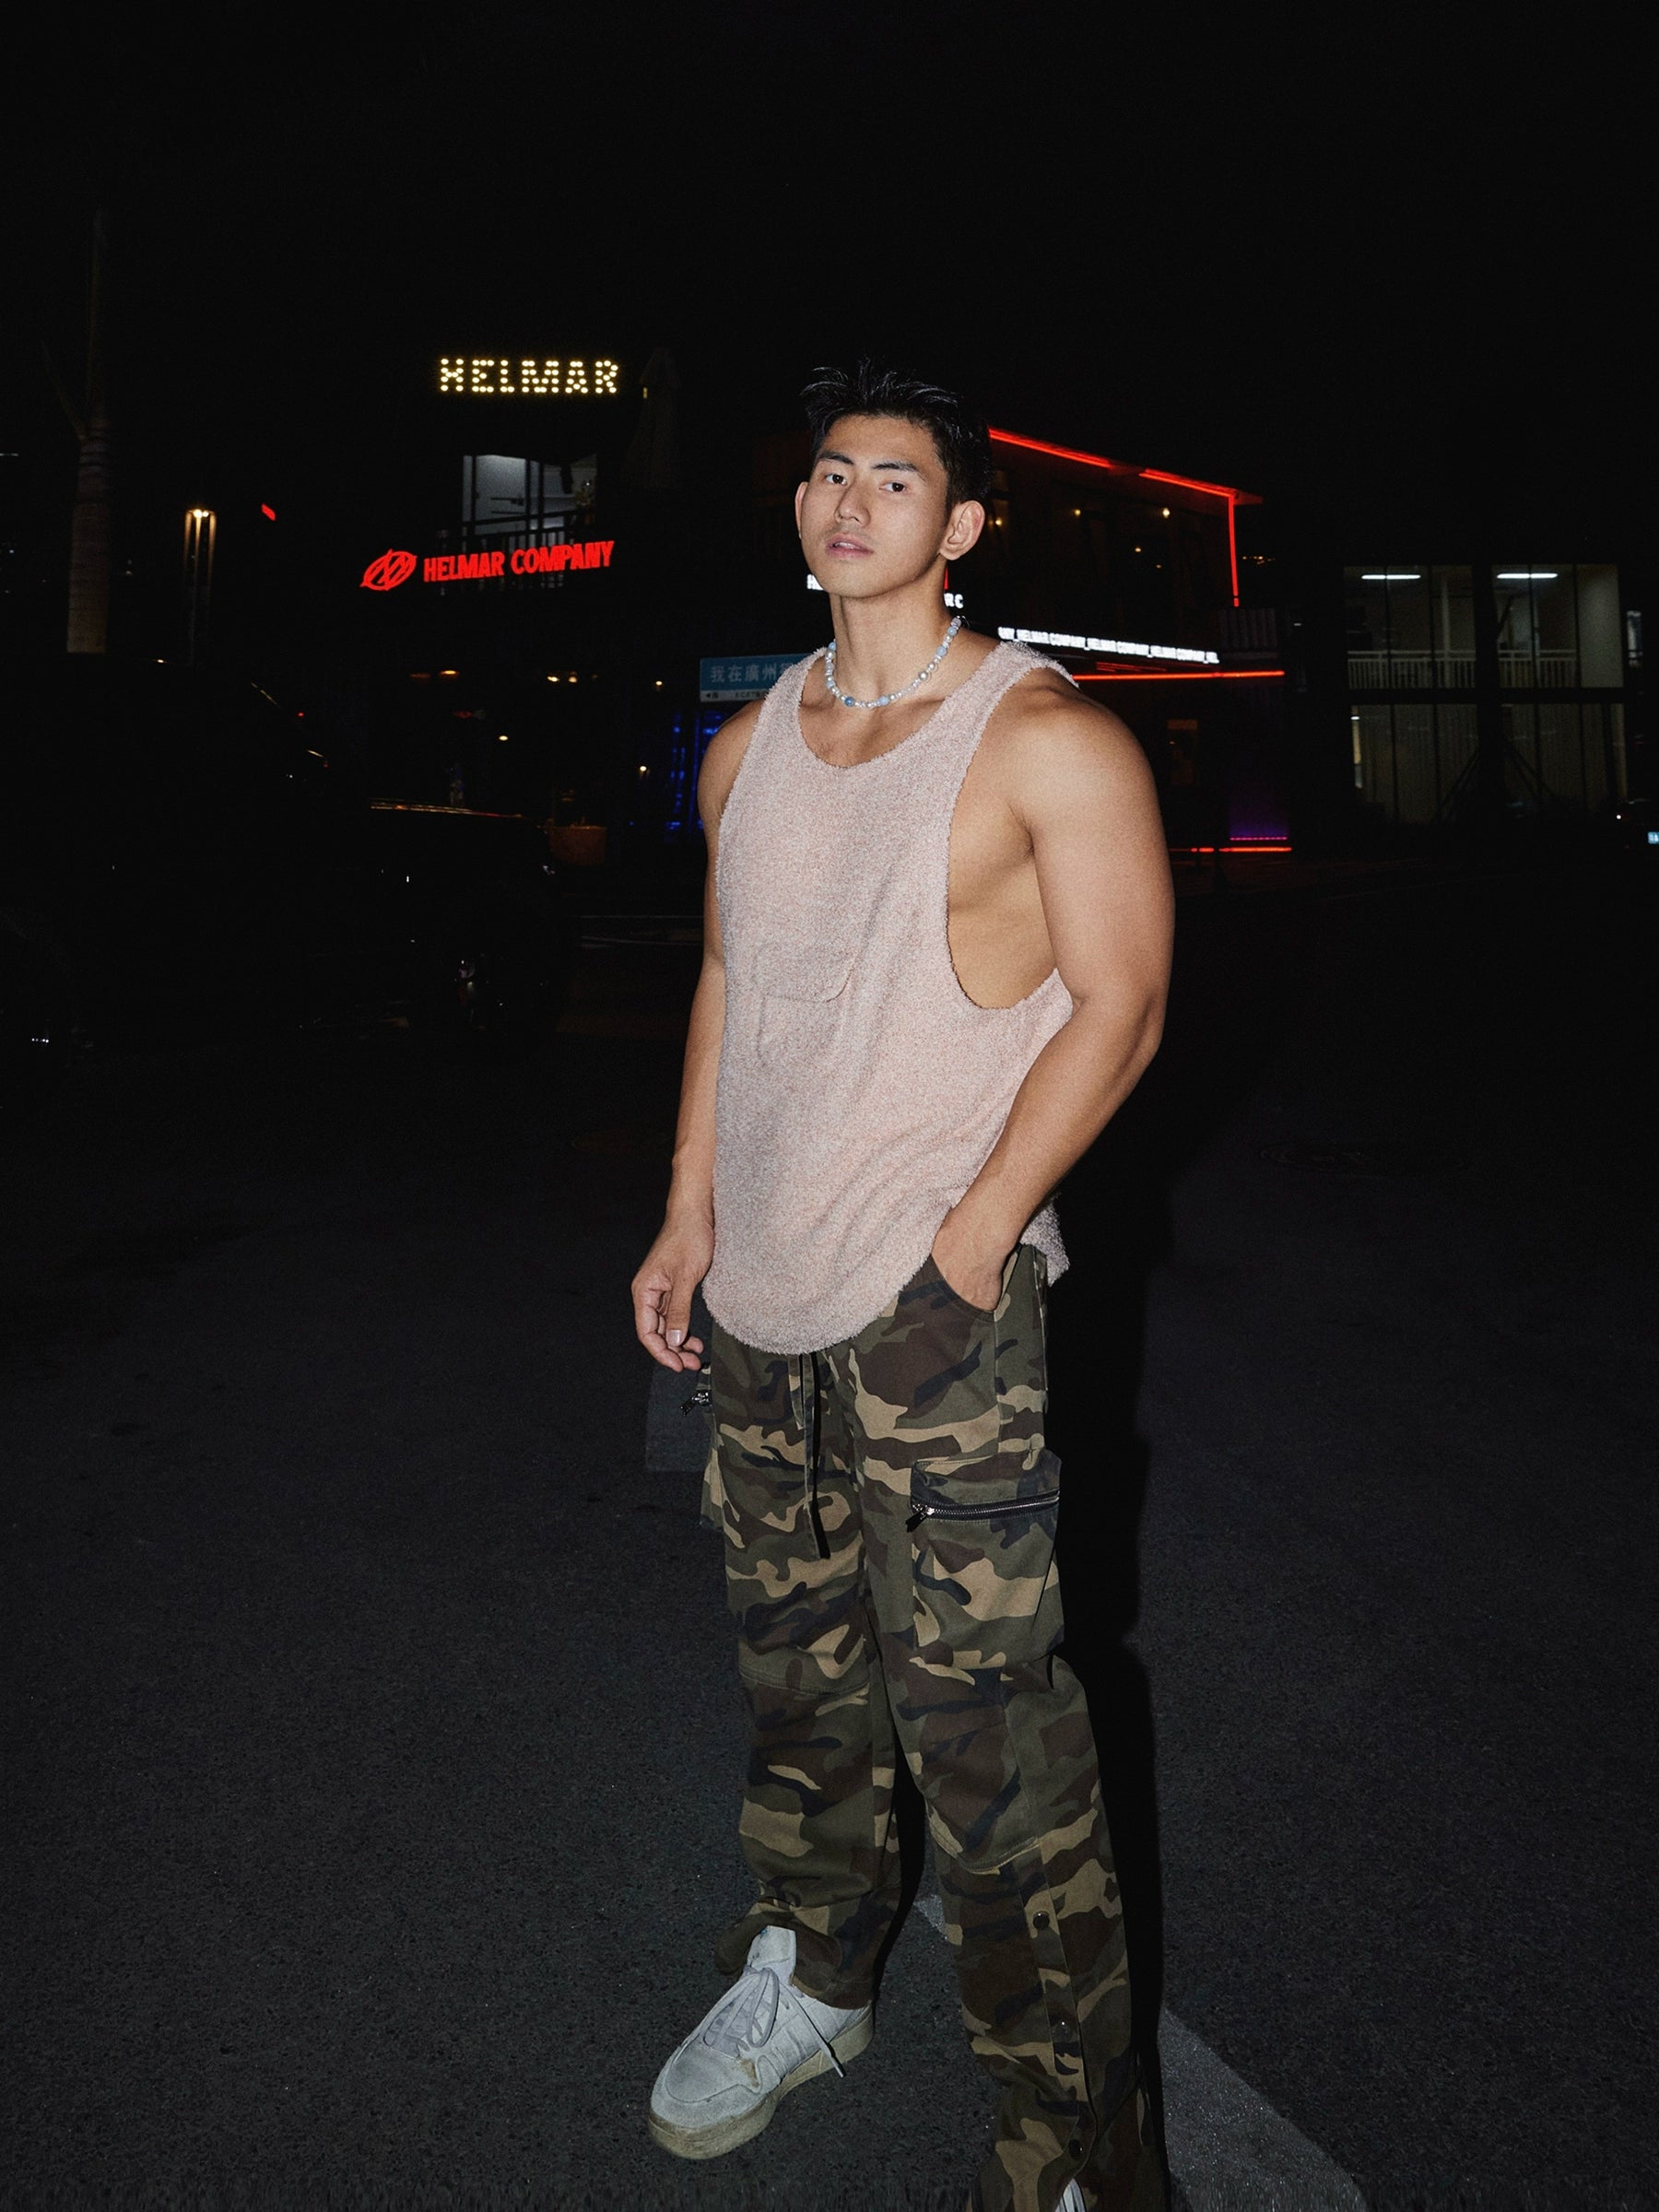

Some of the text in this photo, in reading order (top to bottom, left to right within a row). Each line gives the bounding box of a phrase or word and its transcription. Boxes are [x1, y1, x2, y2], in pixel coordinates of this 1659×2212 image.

[441, 359, 618, 394] HELMAR
[424, 541, 614, 582] HELMAR COMPANY
